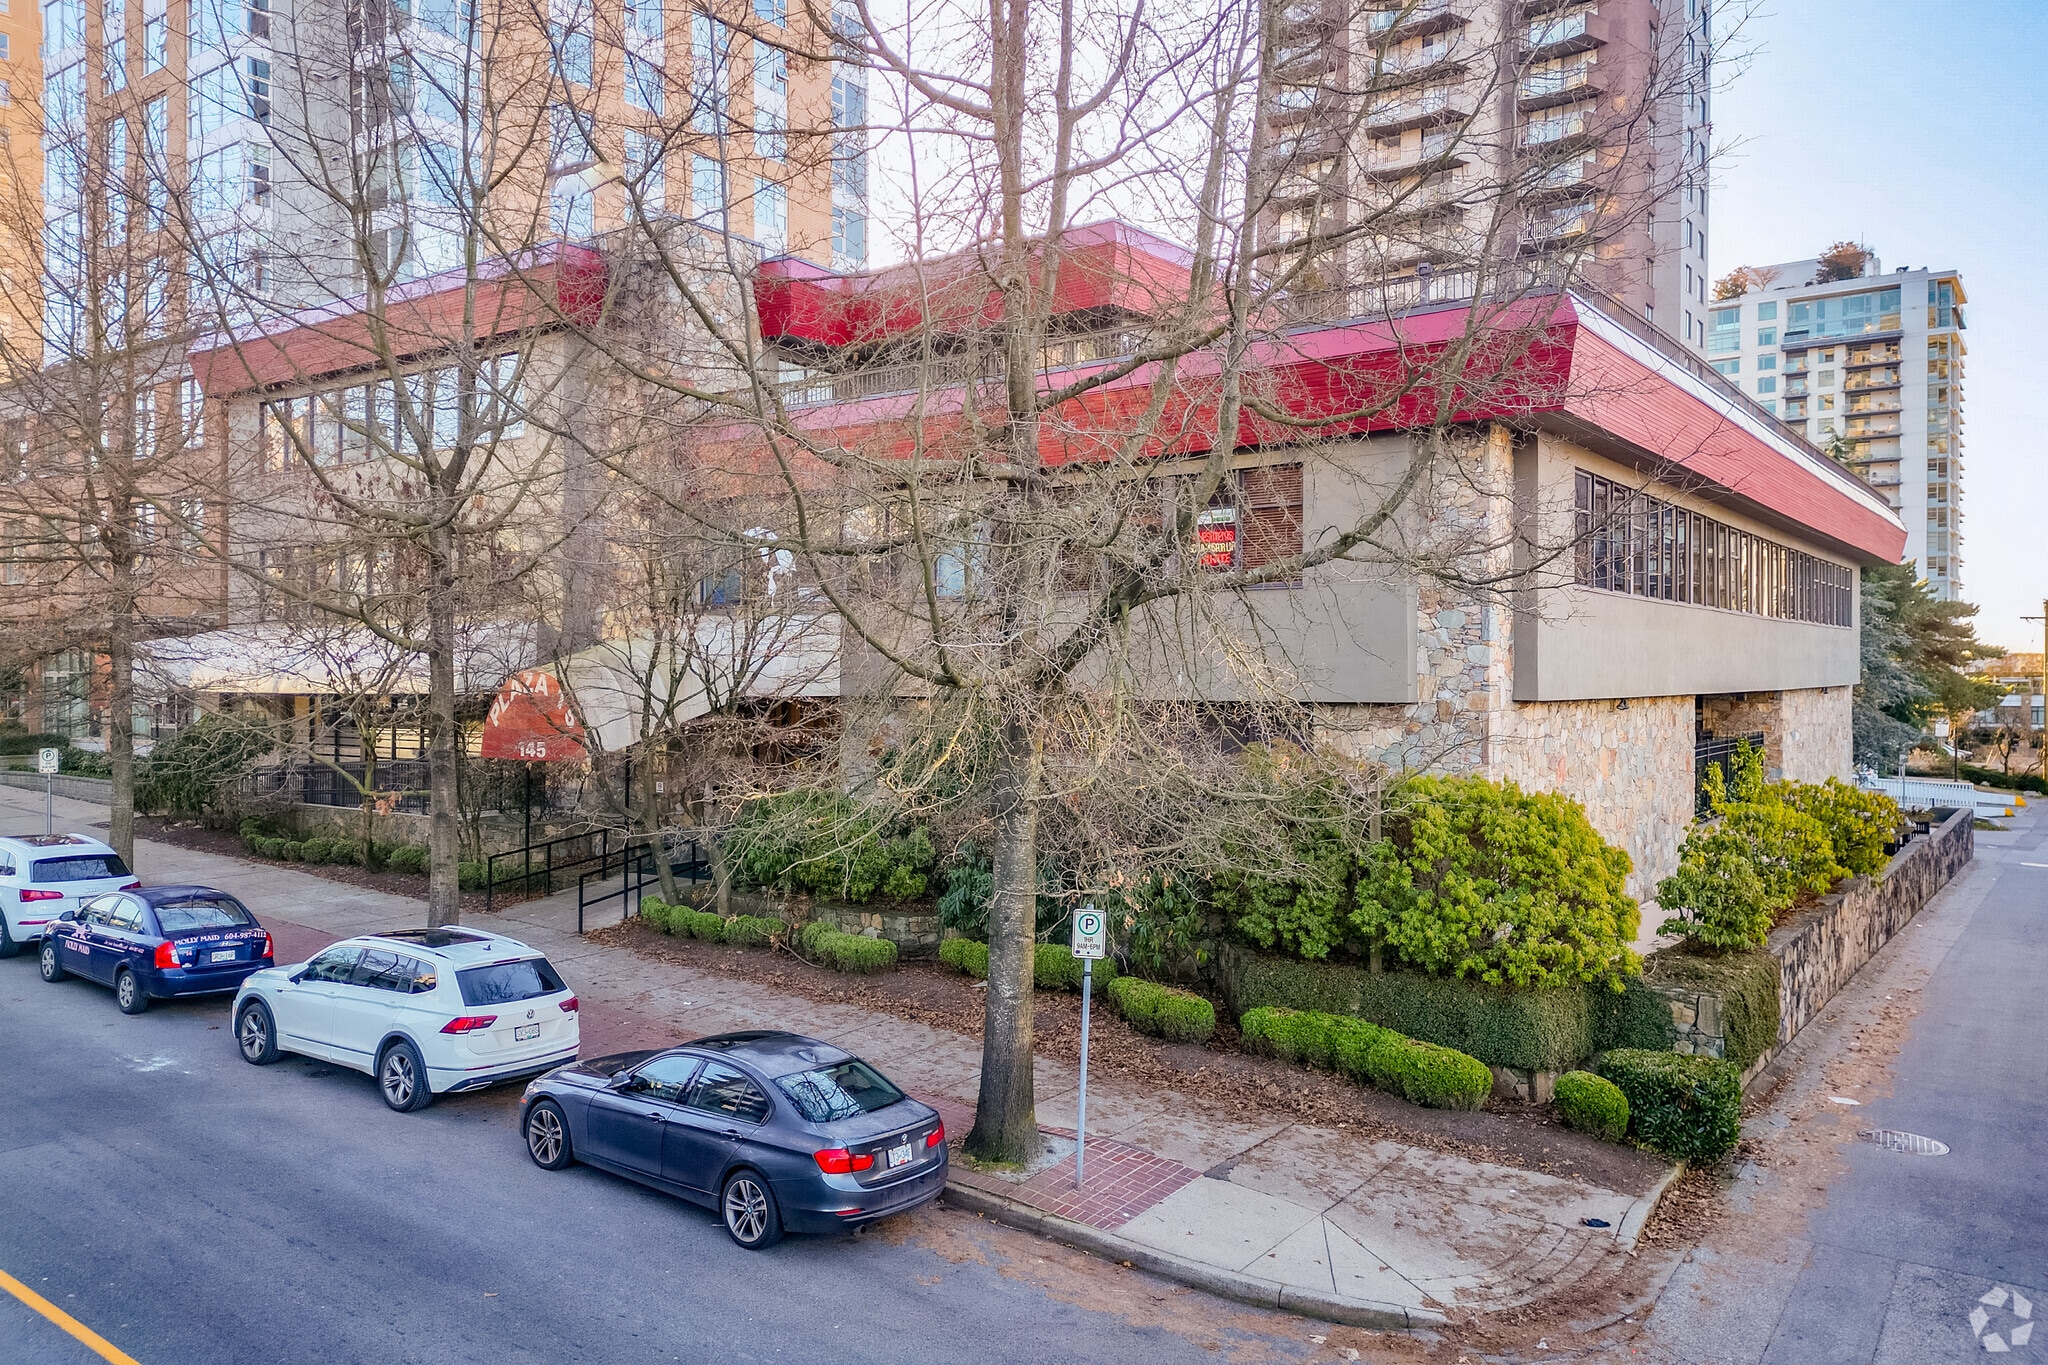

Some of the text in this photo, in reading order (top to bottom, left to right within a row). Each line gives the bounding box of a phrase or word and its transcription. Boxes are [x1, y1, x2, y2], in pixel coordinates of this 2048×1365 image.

[489, 672, 549, 728] PLAZA
[518, 741, 547, 758] 145
[174, 936, 199, 946] MOLLY
[200, 934, 220, 942] MAID
